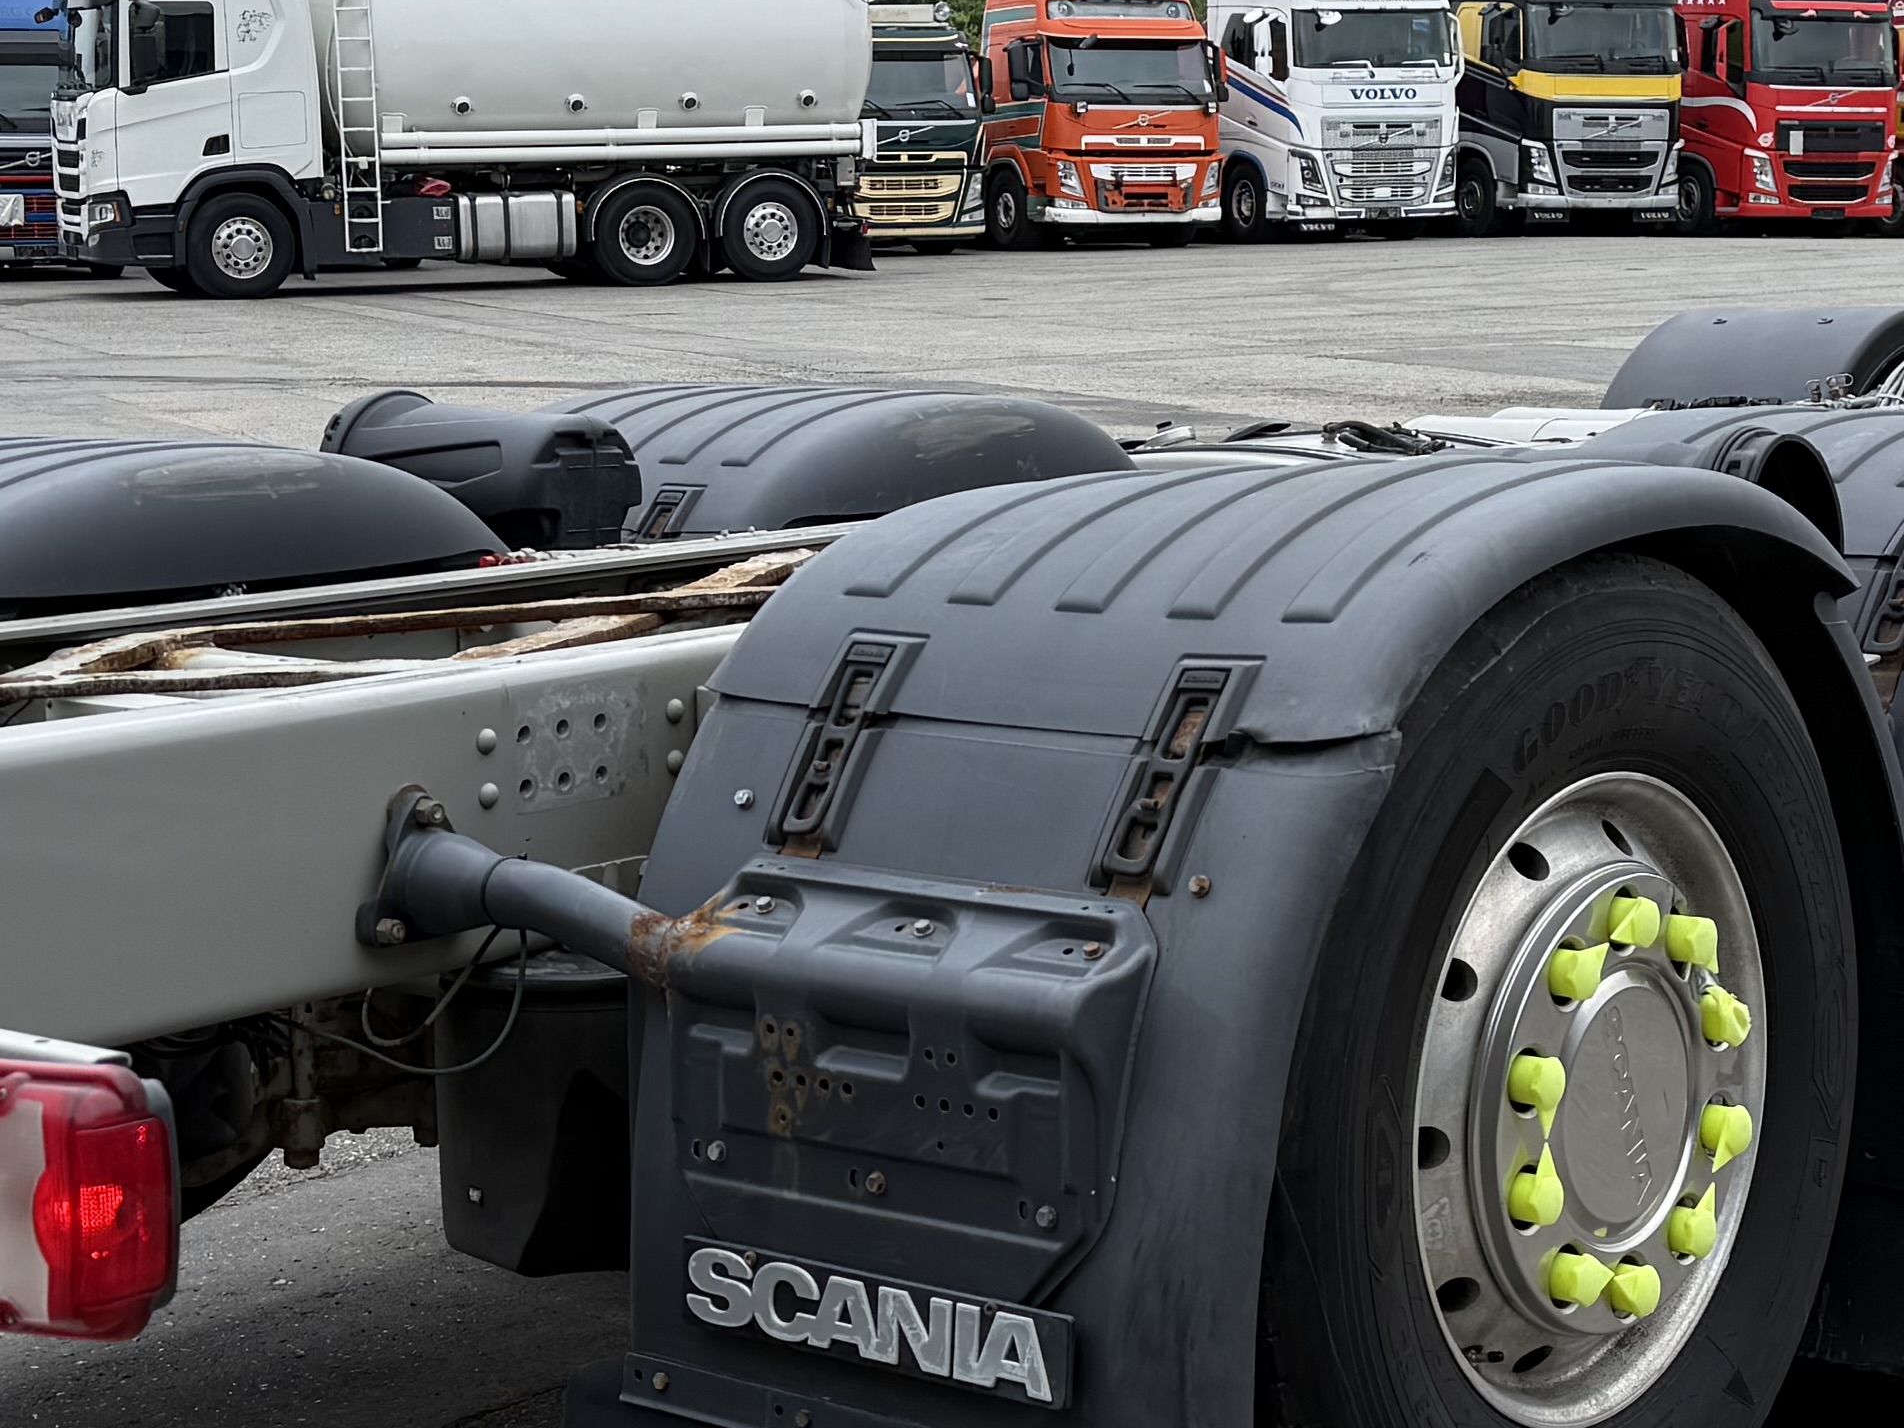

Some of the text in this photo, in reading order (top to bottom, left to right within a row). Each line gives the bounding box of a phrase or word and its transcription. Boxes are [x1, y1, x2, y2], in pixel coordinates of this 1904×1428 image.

[1350, 88, 1417, 100] VOLVO
[1601, 1005, 1653, 1207] SCANIA
[686, 1247, 1053, 1403] SCANIA
